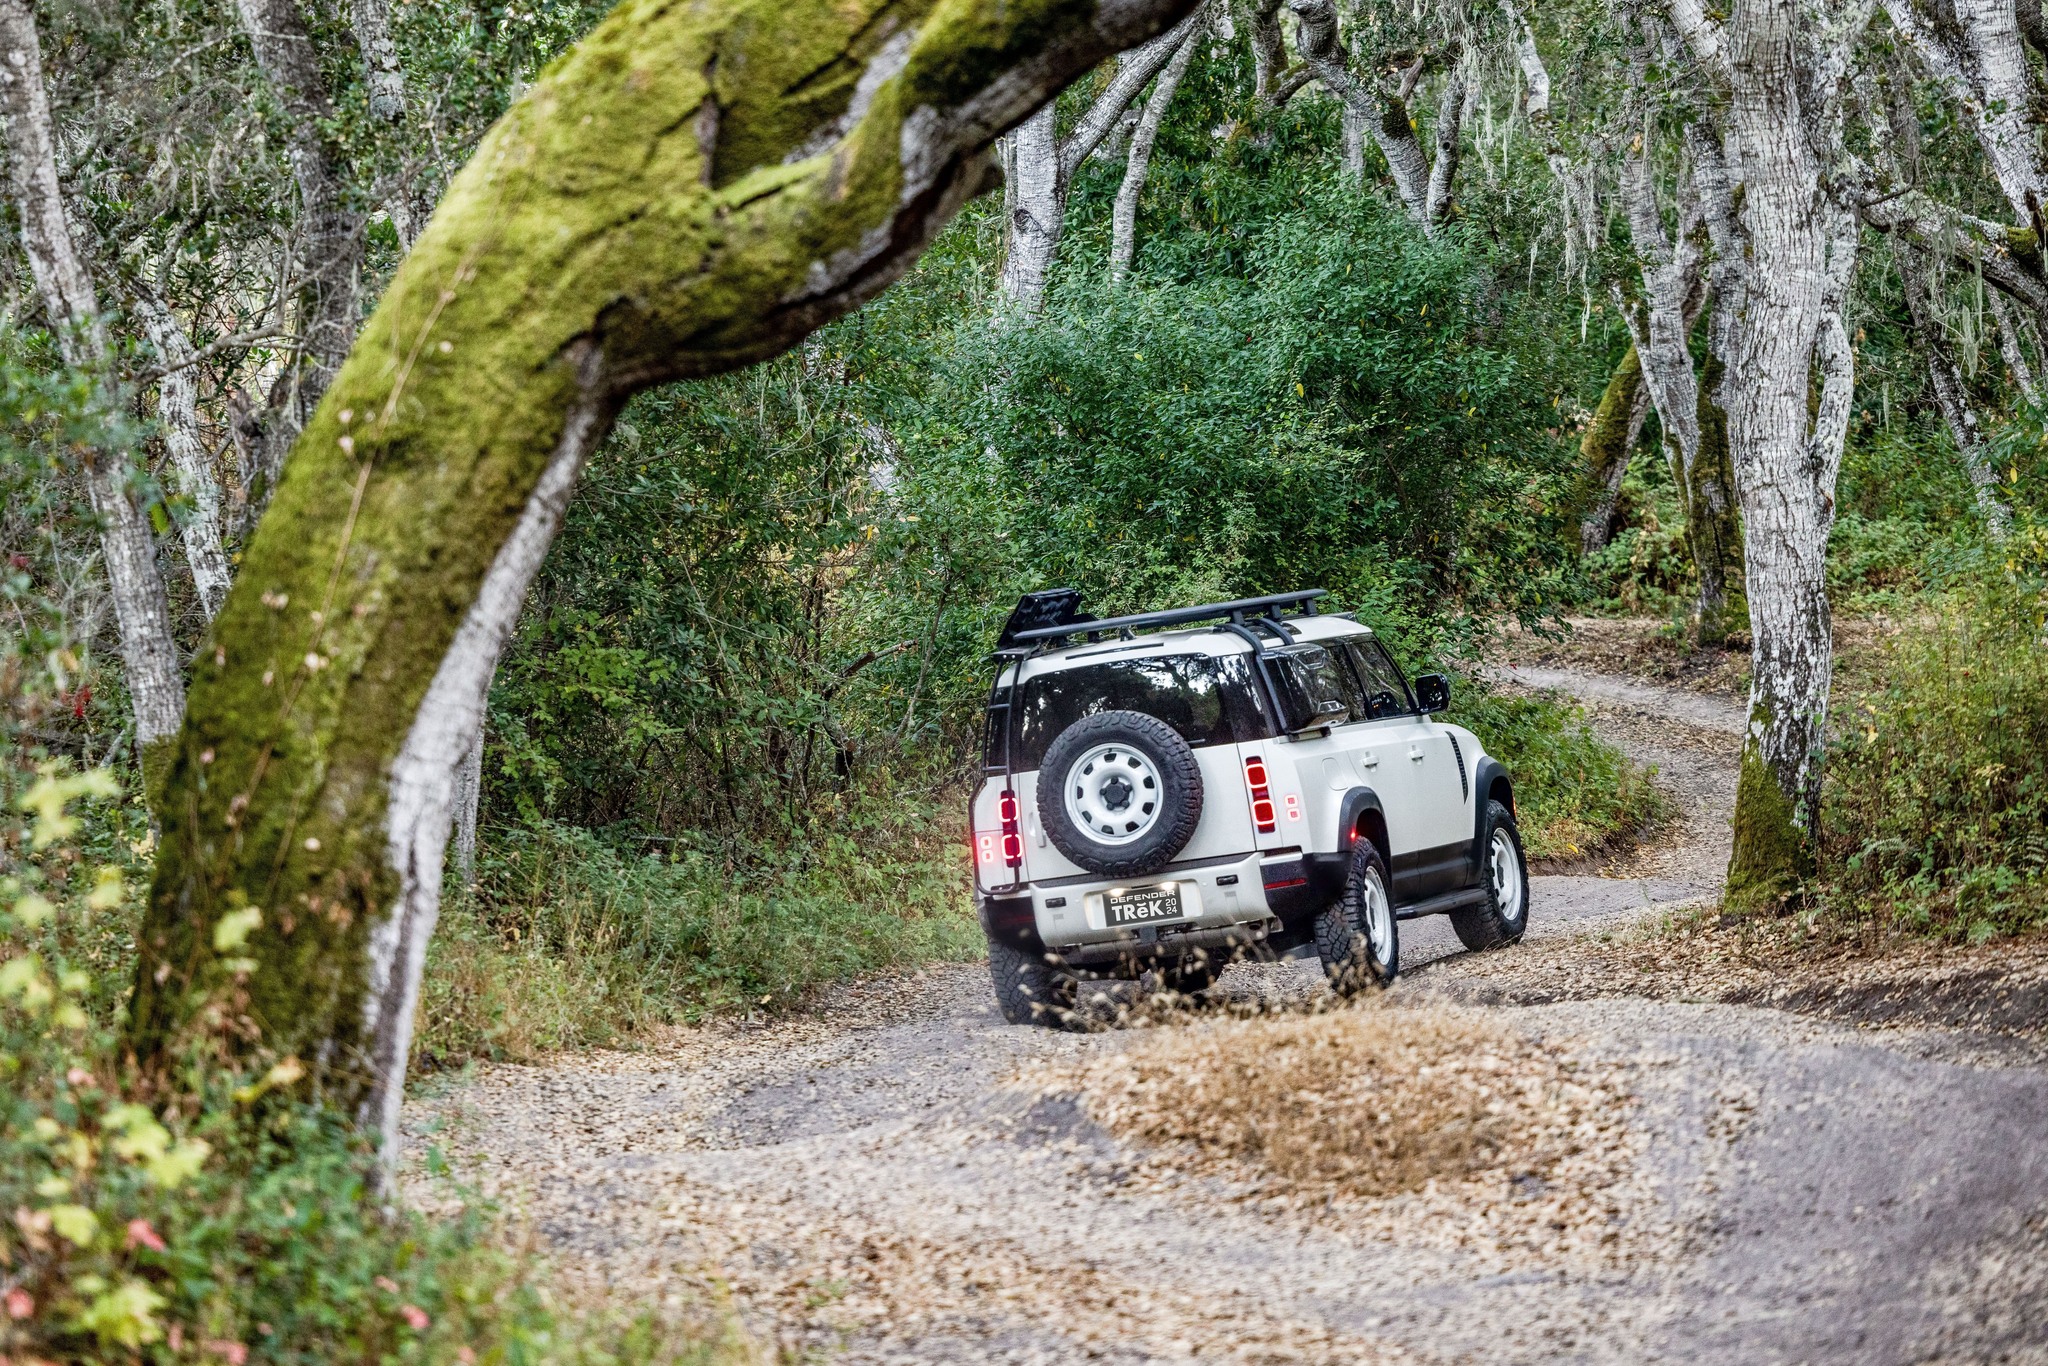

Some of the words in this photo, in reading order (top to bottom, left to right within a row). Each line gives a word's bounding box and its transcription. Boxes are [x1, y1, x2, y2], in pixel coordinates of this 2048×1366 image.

[1110, 889, 1176, 904] DEFENDER
[1165, 898, 1177, 907] 20
[1166, 906, 1178, 914] 24
